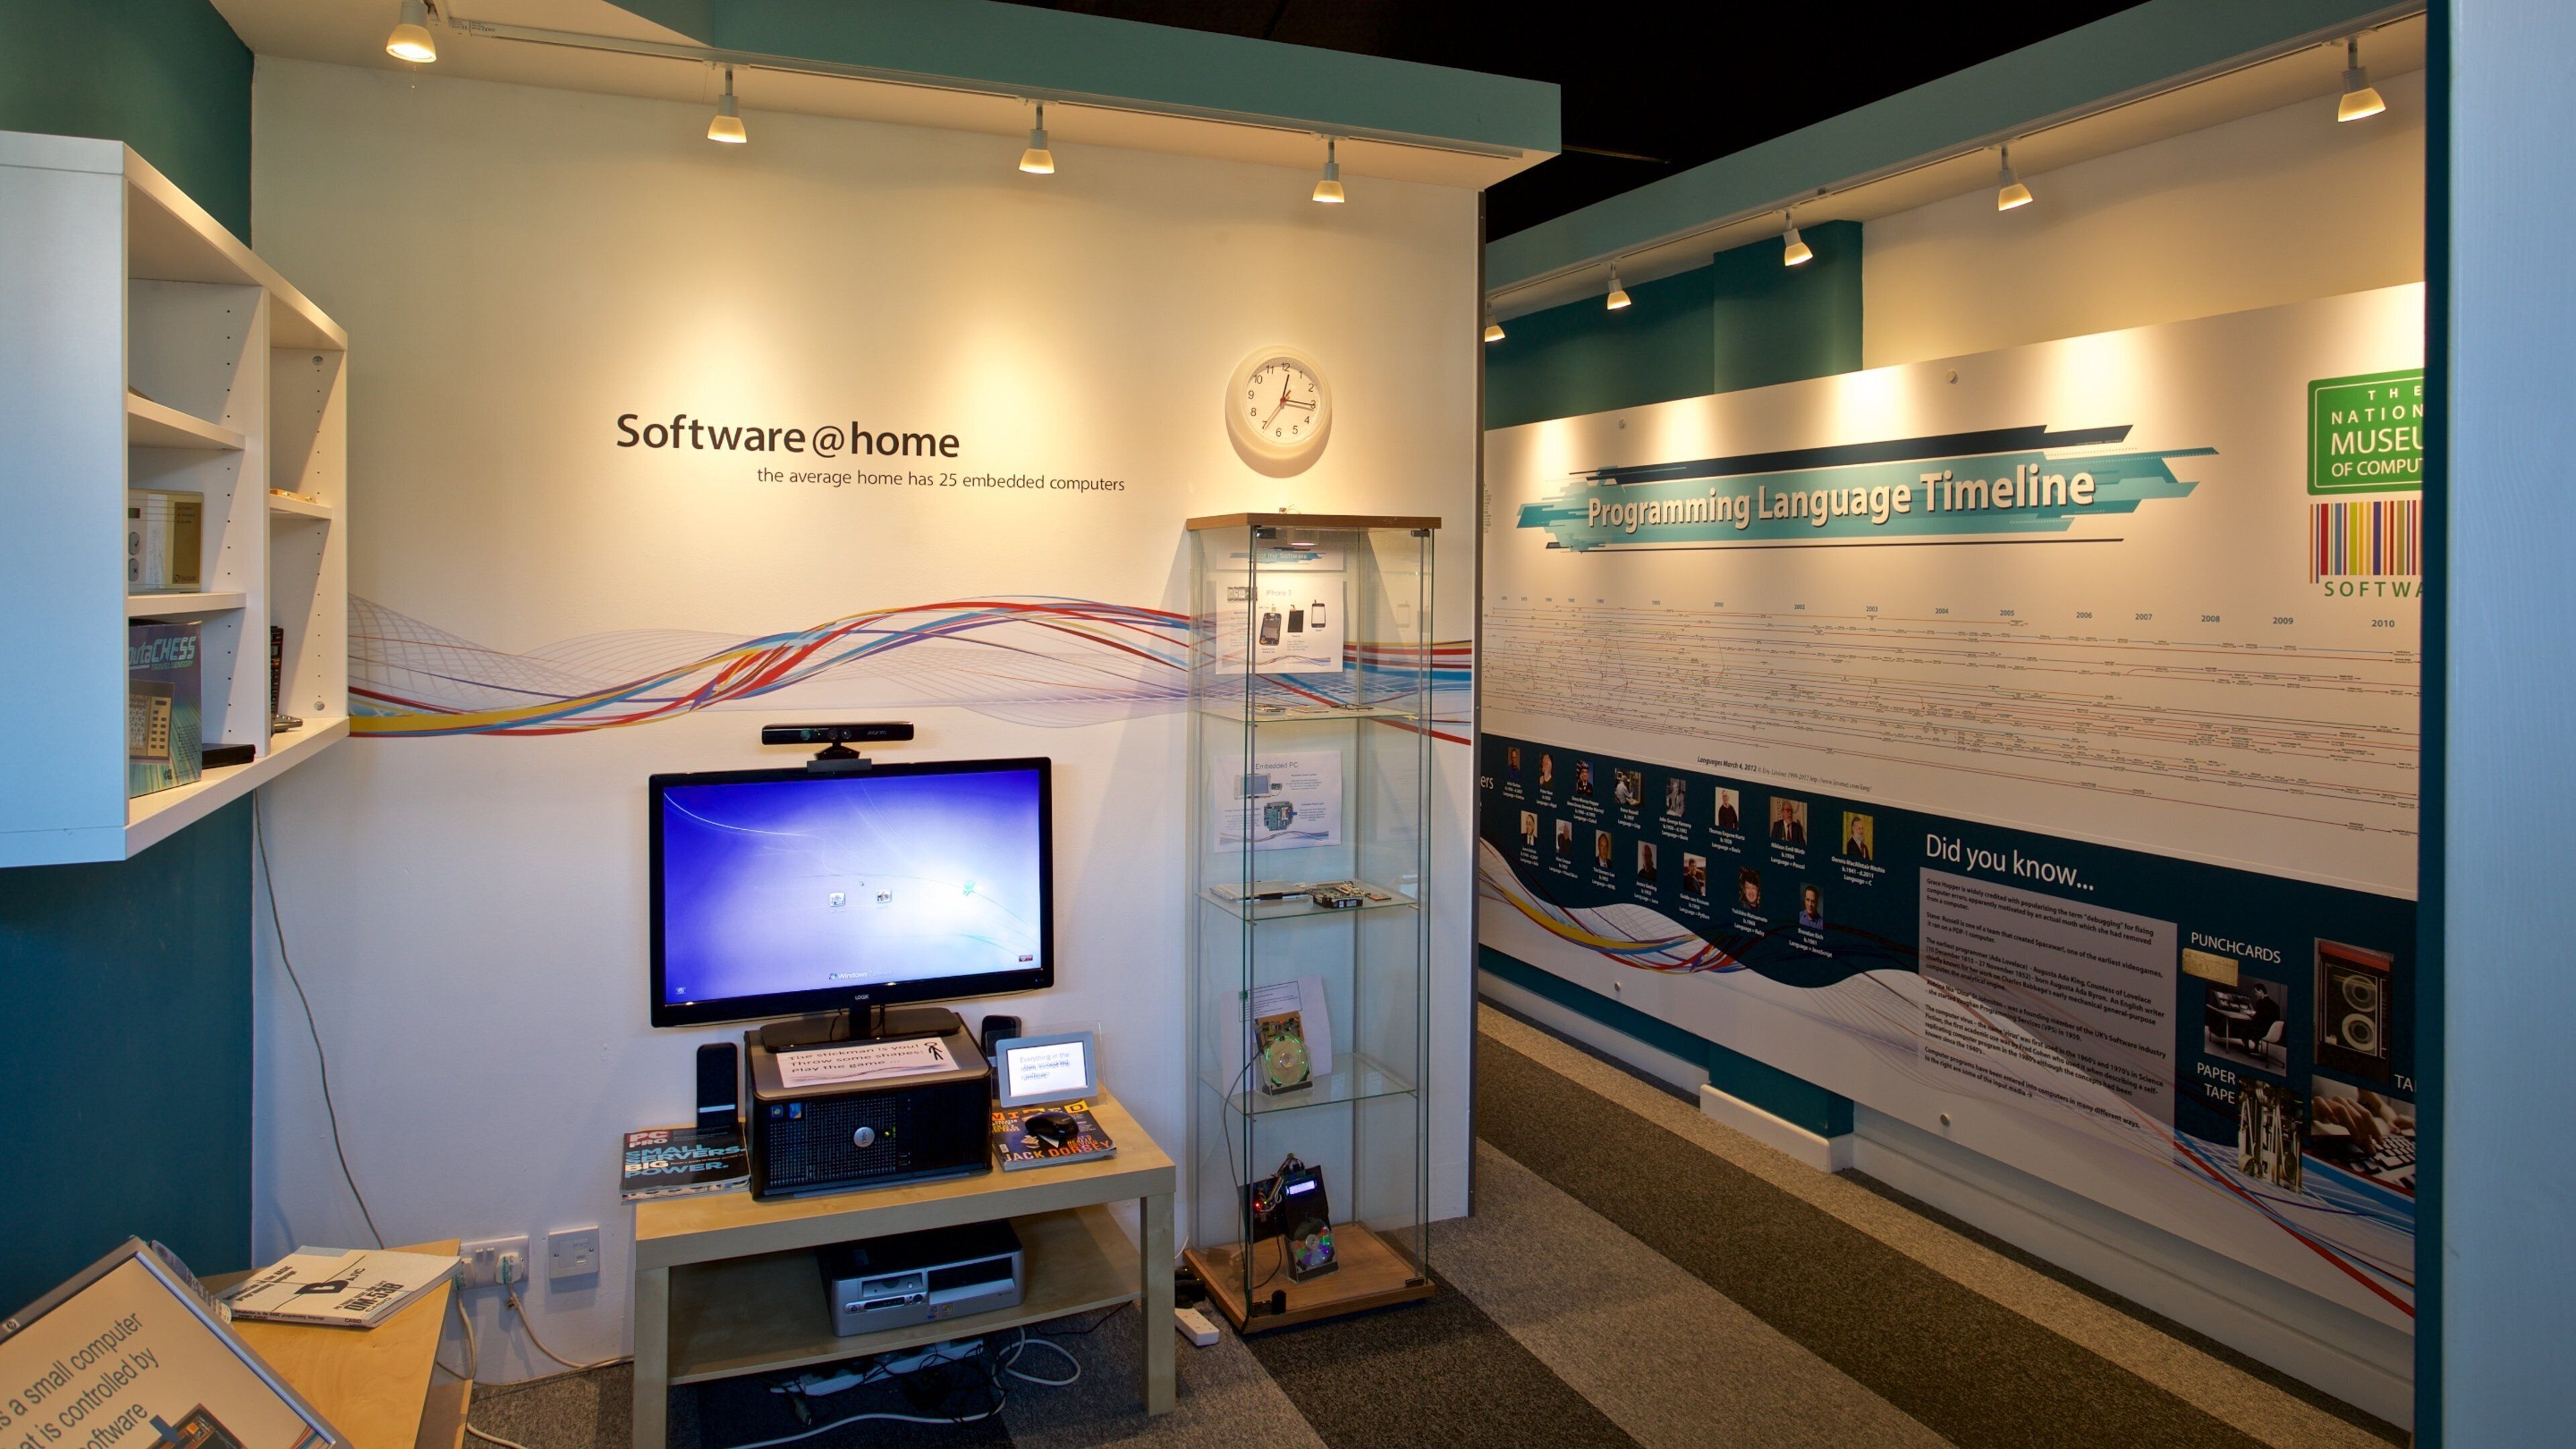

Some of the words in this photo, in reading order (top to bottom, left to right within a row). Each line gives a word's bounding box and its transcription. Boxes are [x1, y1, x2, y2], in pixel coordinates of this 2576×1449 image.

[1267, 366, 1274, 374] 11
[1281, 363, 1291, 372] 12
[1254, 375, 1263, 384] 10
[1299, 370, 1303, 379] 1
[1308, 384, 1314, 392] 2
[2368, 385, 2422, 400] THE
[1248, 390, 1254, 399] 9
[1311, 400, 1316, 409] 3
[1250, 408, 1256, 416] 8
[1304, 416, 1309, 424] 4
[1276, 428, 1281, 437] 6
[1293, 425, 1299, 435] 5
[2332, 463, 2353, 477] OF
[757, 467, 784, 482] the
[789, 472, 852, 488] average
[857, 470, 903, 485] home
[908, 470, 934, 486] has
[939, 472, 957, 486] 25
[963, 473, 1044, 489] embedded
[1049, 478, 1125, 493] computers
[1589, 488, 1750, 534] Programming
[1758, 485, 1912, 527] Language
[1920, 464, 2096, 512] Timeline
[1697, 755, 1723, 767] Languages
[1723, 759, 1739, 769] March
[1744, 763, 1757, 773] 2012
[1927, 833, 1960, 863] Did
[1967, 845, 2006, 872] you
[2014, 850, 2094, 891] know...
[1927, 877, 1941, 887] Grace
[1941, 881, 1960, 891] Hopper
[1966, 888, 1984, 898] widely
[1984, 892, 2006, 902] credited
[2007, 897, 2020, 905] with
[2021, 900, 2057, 915] popularizing
[2057, 908, 2068, 916] the
[2068, 910, 2083, 920] term
[2124, 922, 2133, 931] for
[2135, 925, 2153, 937] fixing
[1927, 888, 1950, 898] computer
[1968, 897, 1996, 910] apparently
[1998, 904, 2025, 915] motivated
[2027, 909, 2034, 918] by
[2043, 914, 2061, 924] actual
[2061, 919, 2078, 928] moth
[2079, 922, 2096, 932] which
[2098, 926, 2108, 935] she
[2110, 928, 2122, 938] had
[2123, 933, 2151, 945] removed
[2191, 932, 2282, 964] PUNCHCARDS
[838, 971, 868, 979] Windows
[817, 1049, 873, 1058] stickman
[1020, 1055, 1051, 1063] Everything
[849, 1060, 885, 1068] game
[2197, 1063, 2235, 1085] PAPER
[2204, 1083, 2235, 1106] TAPE
[629, 1131, 669, 1142] PC
[629, 1138, 668, 1148] PRO
[625, 1144, 710, 1157] SMALL
[625, 1146, 746, 1165] SERVERS.
[1005, 1150, 1045, 1162] JACK
[1048, 1140, 1110, 1158] DORSEY
[625, 1161, 669, 1171] BIG
[625, 1162, 729, 1178] POWER.
[9, 1399, 28, 1415] a
[24, 1360, 74, 1404] small
[70, 1312, 142, 1370] computer
[35, 1424, 62, 1443] is
[58, 1359, 138, 1428] controlled
[129, 1347, 159, 1371] by
